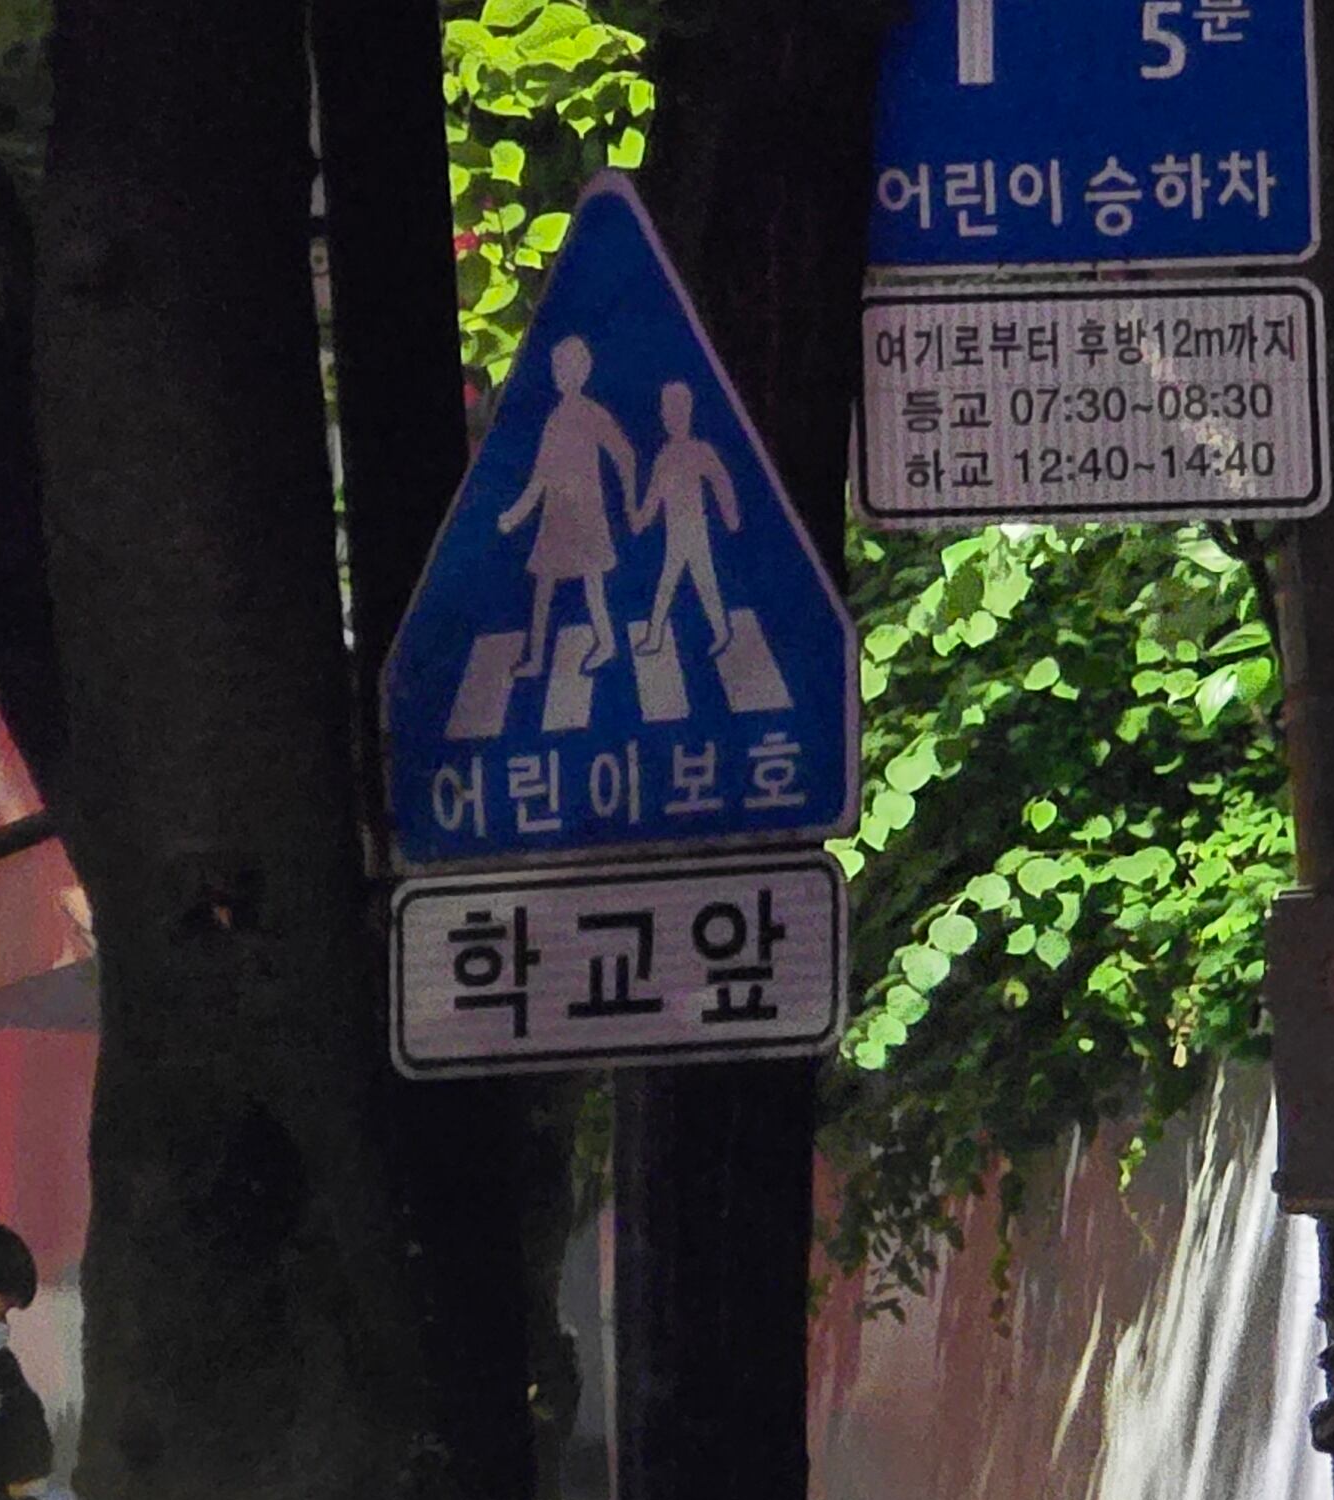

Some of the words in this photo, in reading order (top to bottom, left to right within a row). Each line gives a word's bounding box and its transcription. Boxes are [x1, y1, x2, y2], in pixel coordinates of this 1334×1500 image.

[877, 158, 1063, 237] 어린이
[1084, 150, 1277, 236] 승하차
[875, 321, 1060, 373] 여기로부터
[902, 391, 993, 433] 등교
[1010, 383, 1273, 424] 07:30~08:30
[906, 450, 994, 493] 하교
[447, 889, 786, 1039] 학교앞
